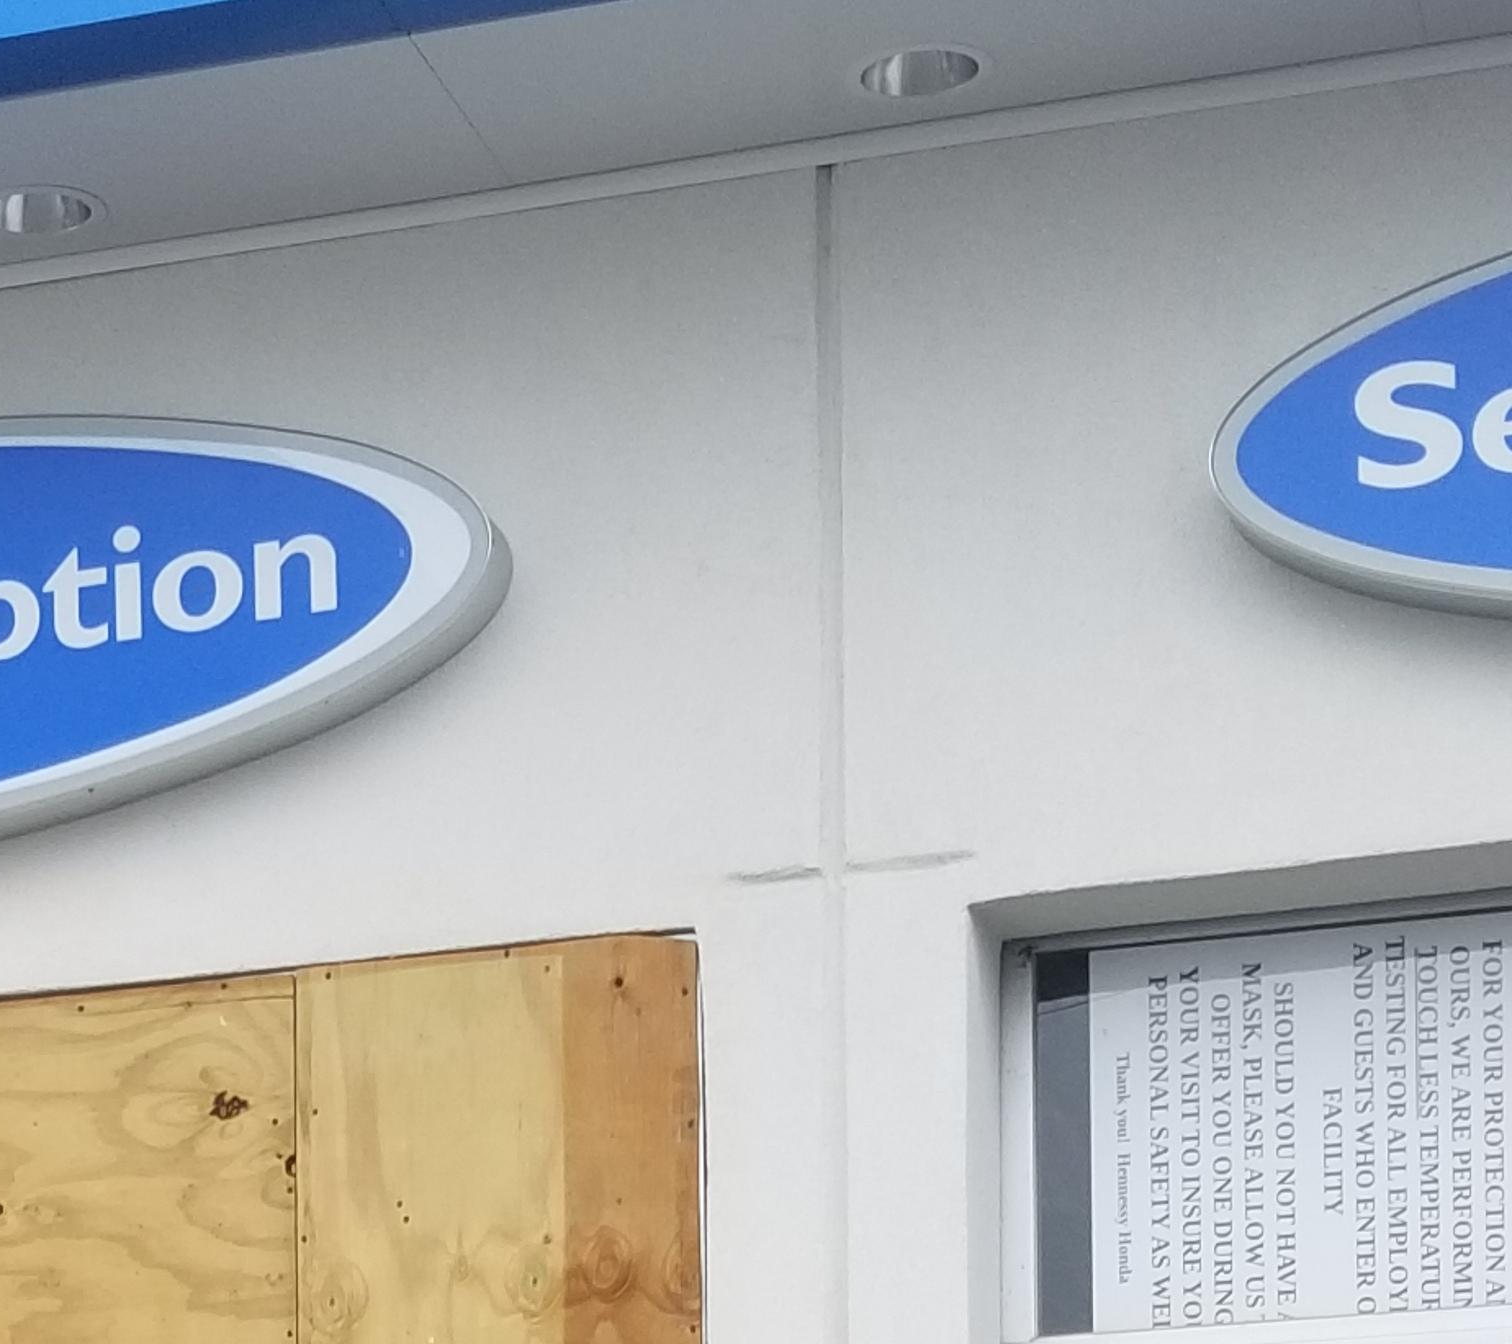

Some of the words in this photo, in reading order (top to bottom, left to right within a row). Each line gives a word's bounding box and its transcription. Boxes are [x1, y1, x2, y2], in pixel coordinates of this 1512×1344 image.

[1353, 943, 1373, 1000] AND
[1386, 936, 1406, 1056] TESTING
[1446, 946, 1470, 1028] OURS,
[1482, 940, 1502, 998] FOR
[1180, 966, 1199, 1045] YOUR
[1212, 994, 1231, 1082] OFFER
[1240, 963, 1262, 1050] MASK,
[1274, 982, 1294, 1094] SHOULD
[1116, 1053, 1131, 1105] Thank
[1148, 976, 1168, 1120] PERSONAL
[1354, 1009, 1374, 1114] GUESTS
[1451, 1034, 1470, 1079] WE
[1483, 1004, 1503, 1083] YOUR
[1181, 1052, 1200, 1124] VISIT
[1213, 1091, 1232, 1147] YOU
[1243, 1058, 1262, 1160] PLEASE
[1387, 1064, 1406, 1120] FOR
[1451, 1086, 1471, 1142] ARE
[1182, 1130, 1200, 1166] TO
[1276, 1103, 1295, 1159] YOU
[1323, 1088, 1342, 1216] FACILITY
[1356, 1122, 1375, 1188] WHO
[1388, 1128, 1407, 1180] ALL
[1114, 1154, 1131, 1226] Hennessy
[1150, 1127, 1170, 1229] SAFETY
[1213, 1156, 1232, 1212] ONE
[1276, 1168, 1295, 1225] NOT
[1484, 1091, 1505, 1272] PROTECTION
[1152, 1236, 1170, 1268] AS
[1182, 1176, 1201, 1274] INSURE
[1245, 1168, 1264, 1267] ALLOW
[1356, 1198, 1376, 1288] ENTER
[1118, 1232, 1132, 1284] Honda
[1214, 1221, 1233, 1324] DURING
[1246, 1277, 1265, 1308] US
[1276, 1233, 1296, 1306] HAVE
[1486, 1279, 1506, 1305] A
